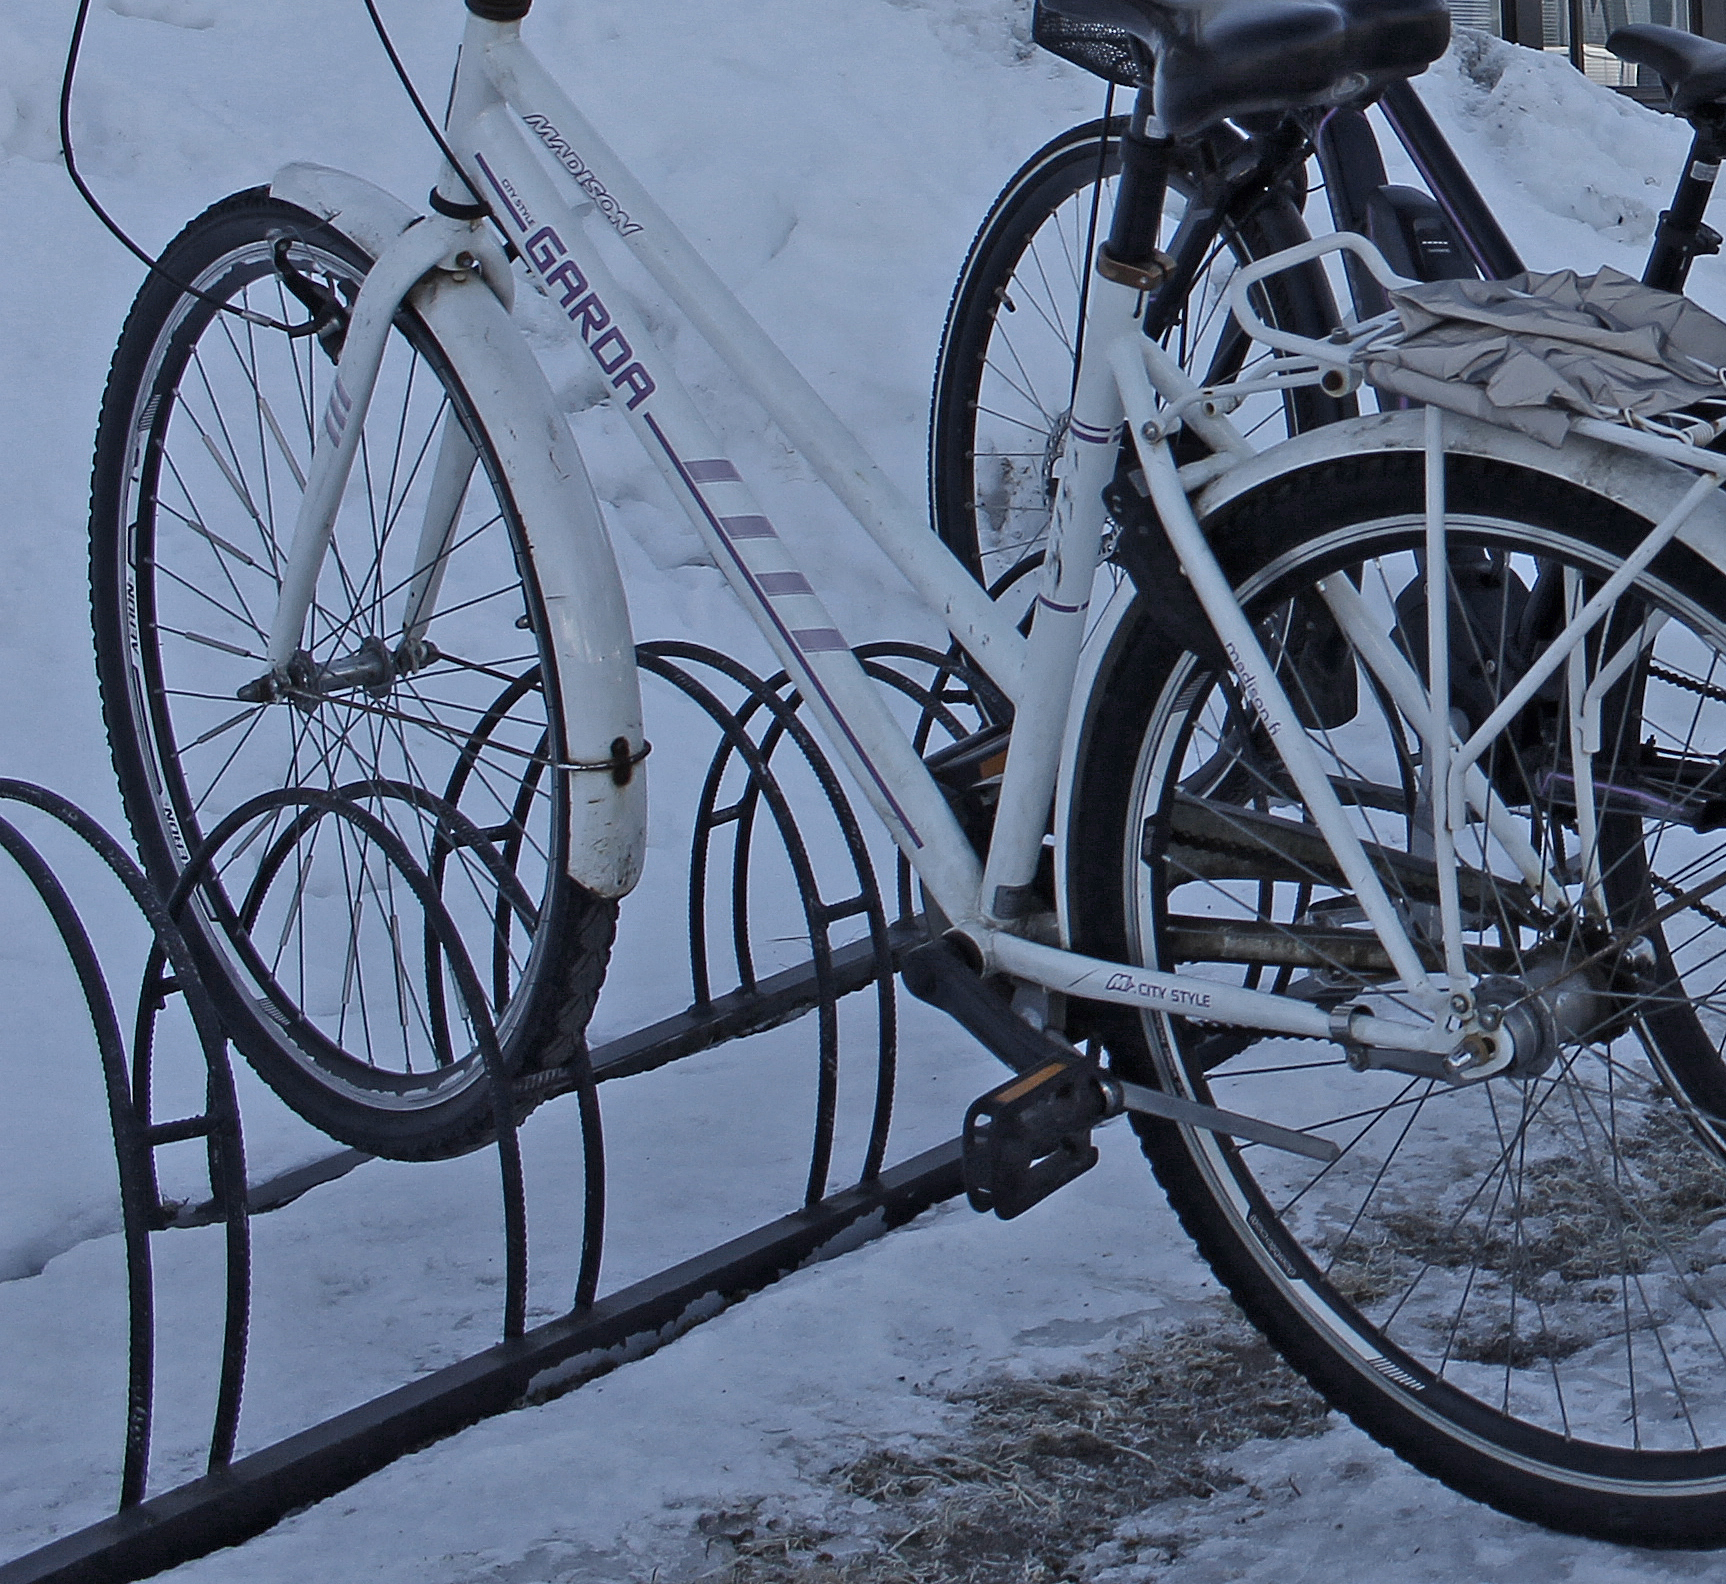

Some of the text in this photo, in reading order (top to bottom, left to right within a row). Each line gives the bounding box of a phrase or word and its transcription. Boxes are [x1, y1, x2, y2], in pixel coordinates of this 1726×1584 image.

[502, 178, 535, 226] CITY STYLE
[523, 113, 644, 238] MADISON
[525, 225, 656, 412] GARDA
[1138, 983, 1167, 1000] CITY
[1171, 989, 1212, 1008] STYLE
